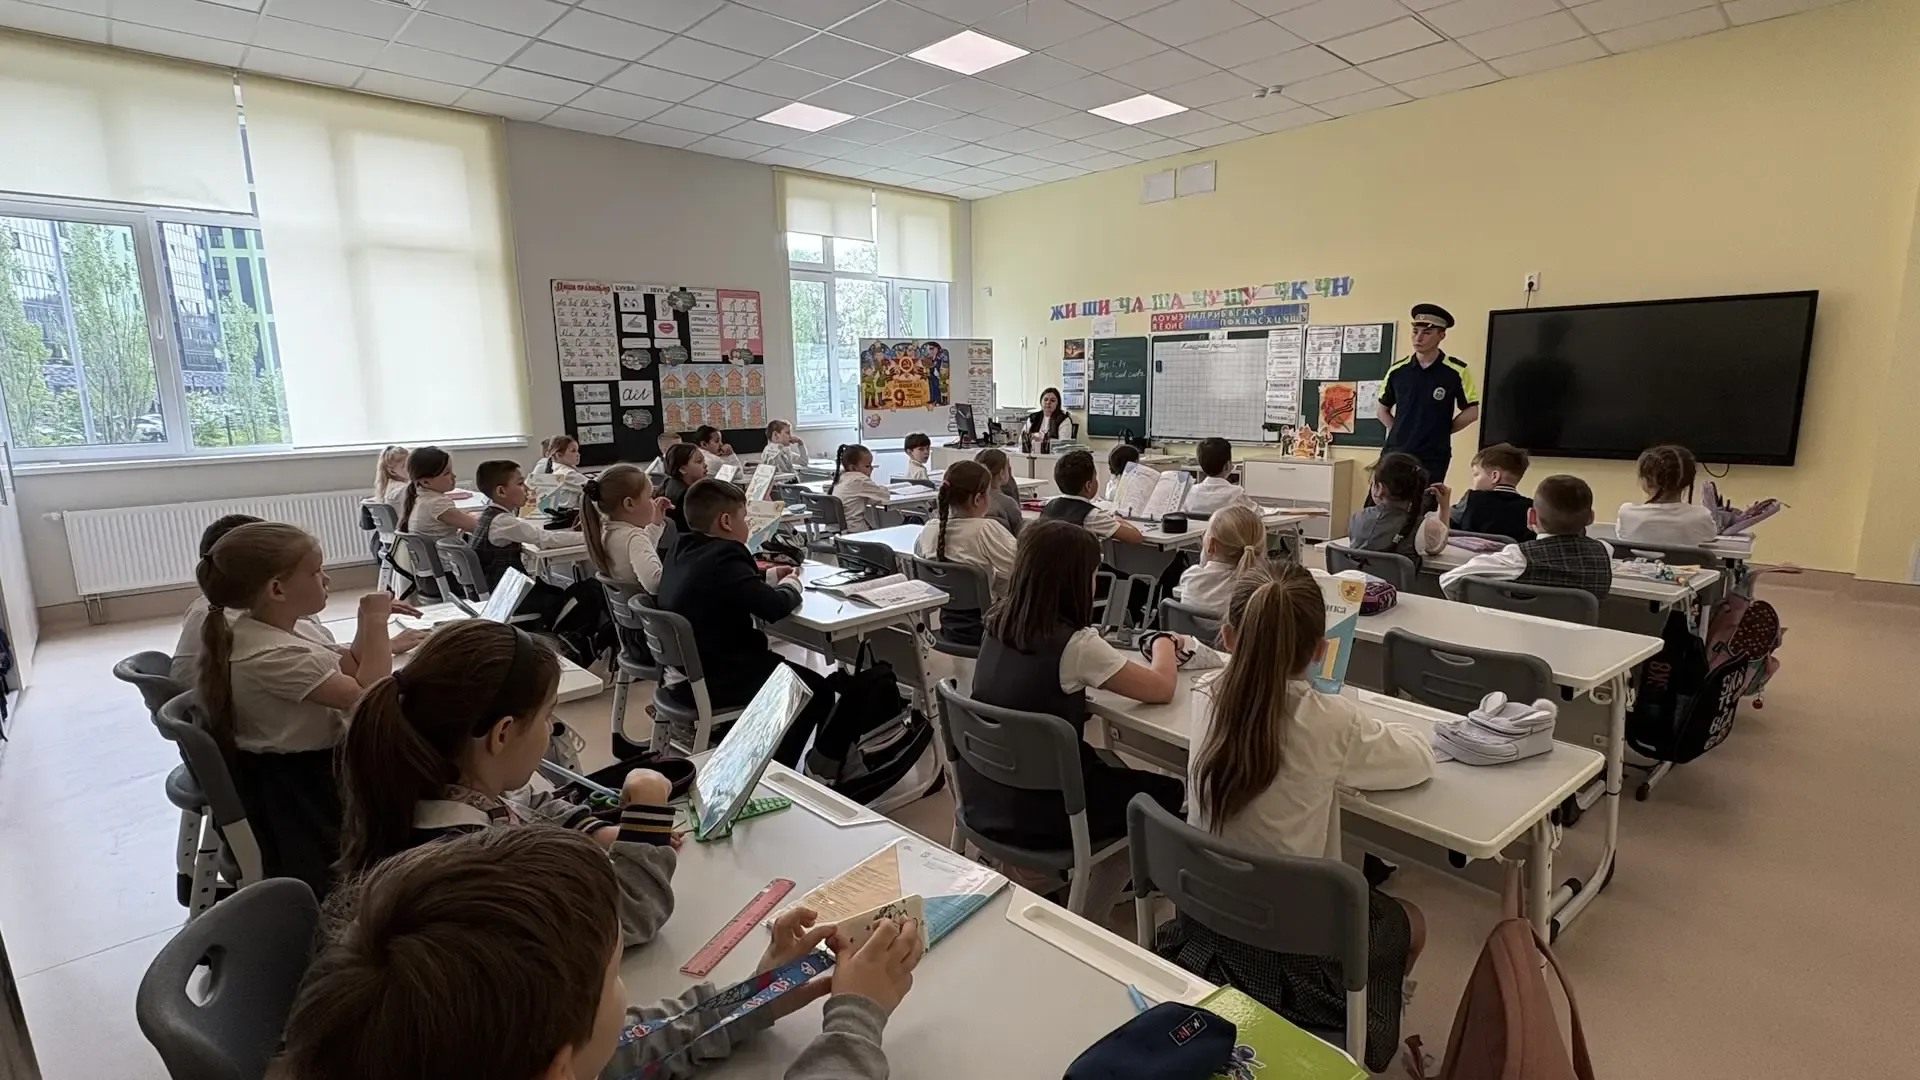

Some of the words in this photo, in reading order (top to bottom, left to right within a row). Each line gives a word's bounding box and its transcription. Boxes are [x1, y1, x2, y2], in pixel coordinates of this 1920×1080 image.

[1050, 303, 1077, 321] ЖИ
[1082, 299, 1110, 316] ШИ
[1115, 296, 1144, 314] ЧА
[1275, 280, 1308, 301] ЧК
[1315, 276, 1351, 297] ЧН
[894, 388, 905, 407] 9
